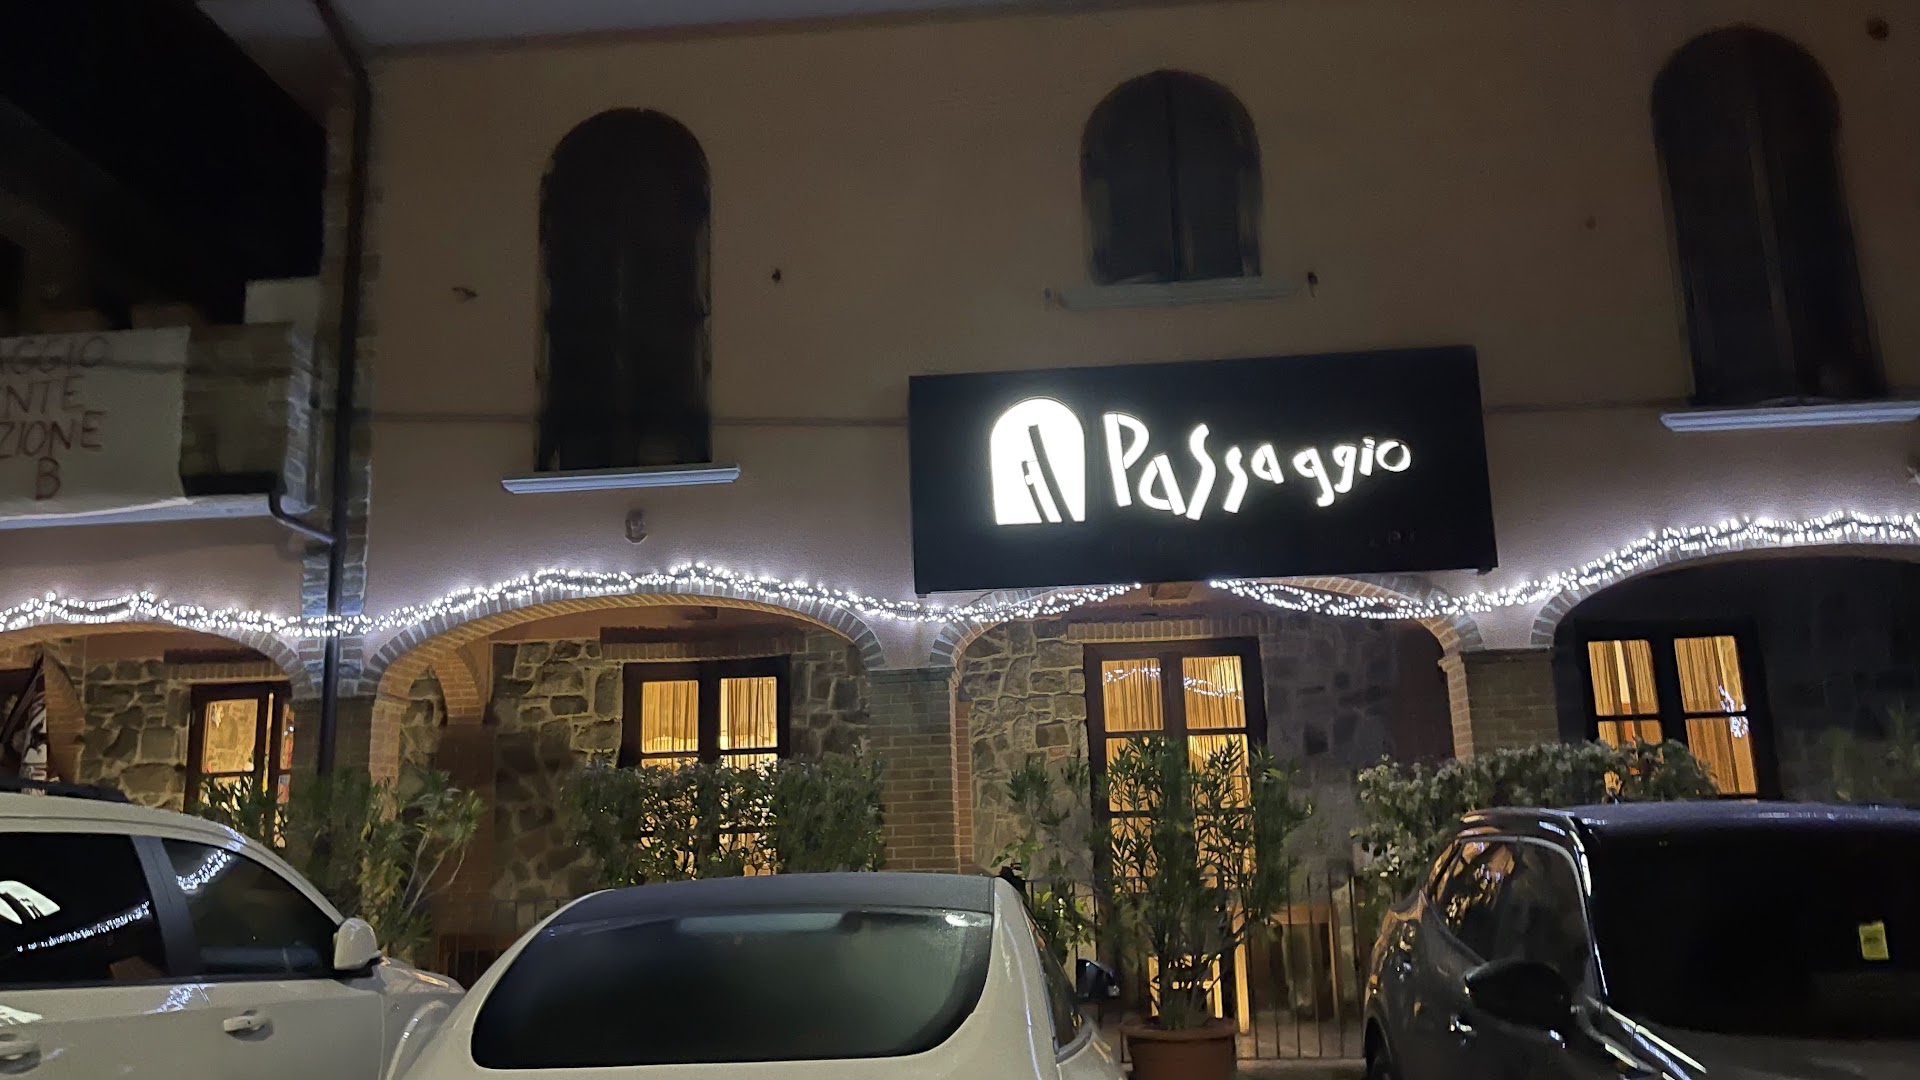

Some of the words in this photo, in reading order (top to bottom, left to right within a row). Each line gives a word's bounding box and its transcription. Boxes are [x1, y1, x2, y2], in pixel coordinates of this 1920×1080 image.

[0, 336, 110, 374] GGIO
[0, 374, 85, 419] NTE
[34, 456, 61, 501] B
